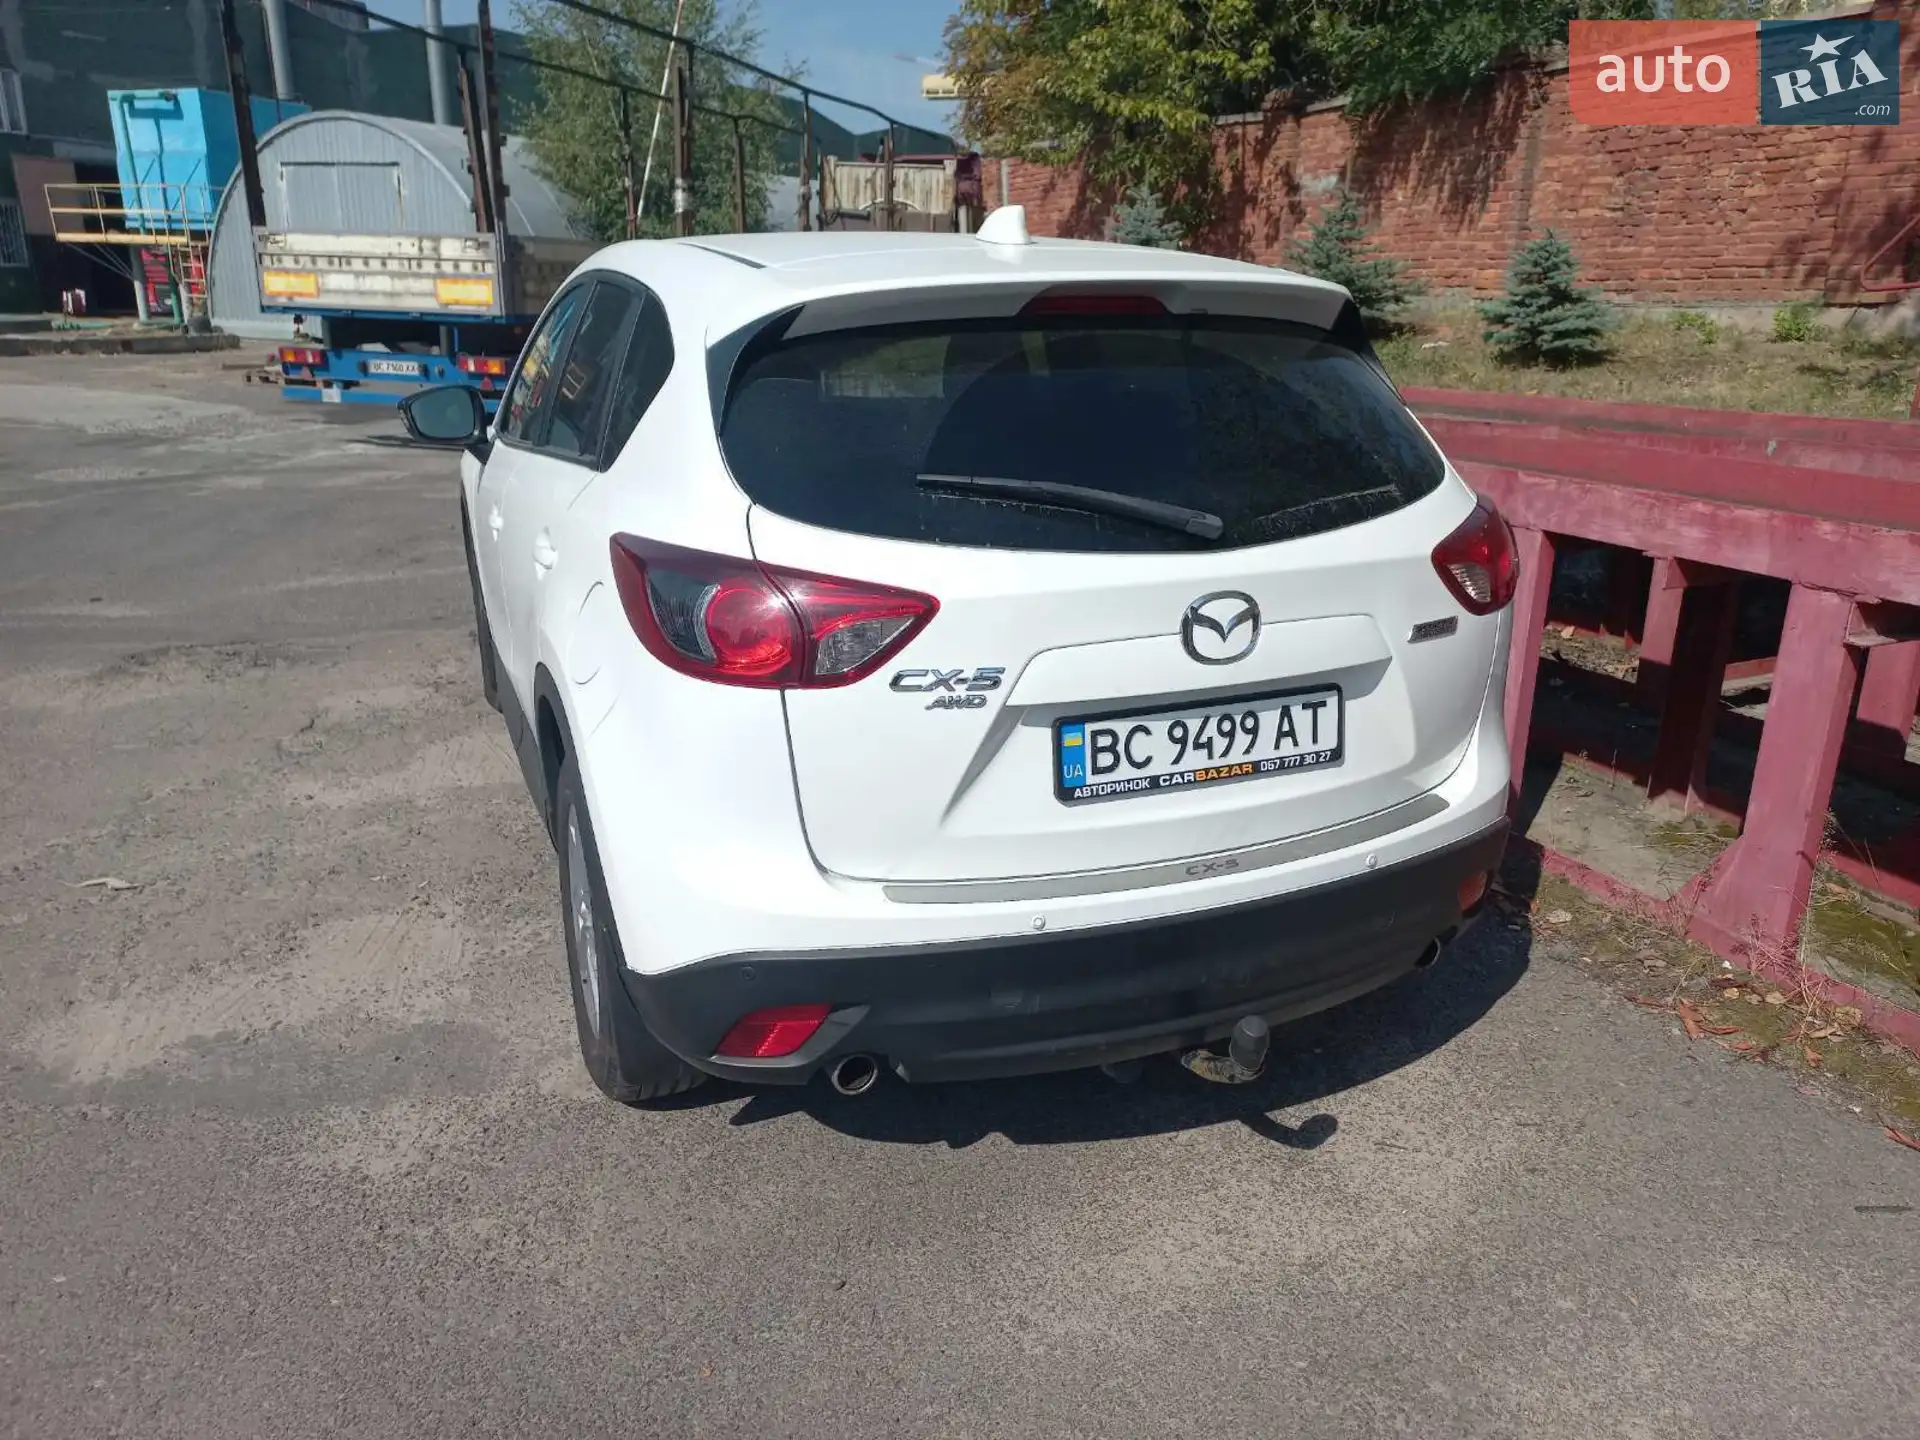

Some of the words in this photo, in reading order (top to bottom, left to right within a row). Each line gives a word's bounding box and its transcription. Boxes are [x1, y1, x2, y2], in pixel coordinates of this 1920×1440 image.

[889, 667, 1006, 692] CX-5
[924, 694, 988, 711] AWD
[1090, 724, 1153, 775] BC
[1167, 710, 1260, 765] 9499
[1273, 700, 1327, 750] AT
[1063, 764, 1084, 779] UA
[1074, 778, 1151, 799] АВТОРИНОК
[1159, 764, 1253, 786] CARBAZAR
[1260, 760, 1280, 772] 067
[1284, 755, 1302, 768] 777
[1303, 752, 1317, 765] 30
[1319, 751, 1332, 762] 27
